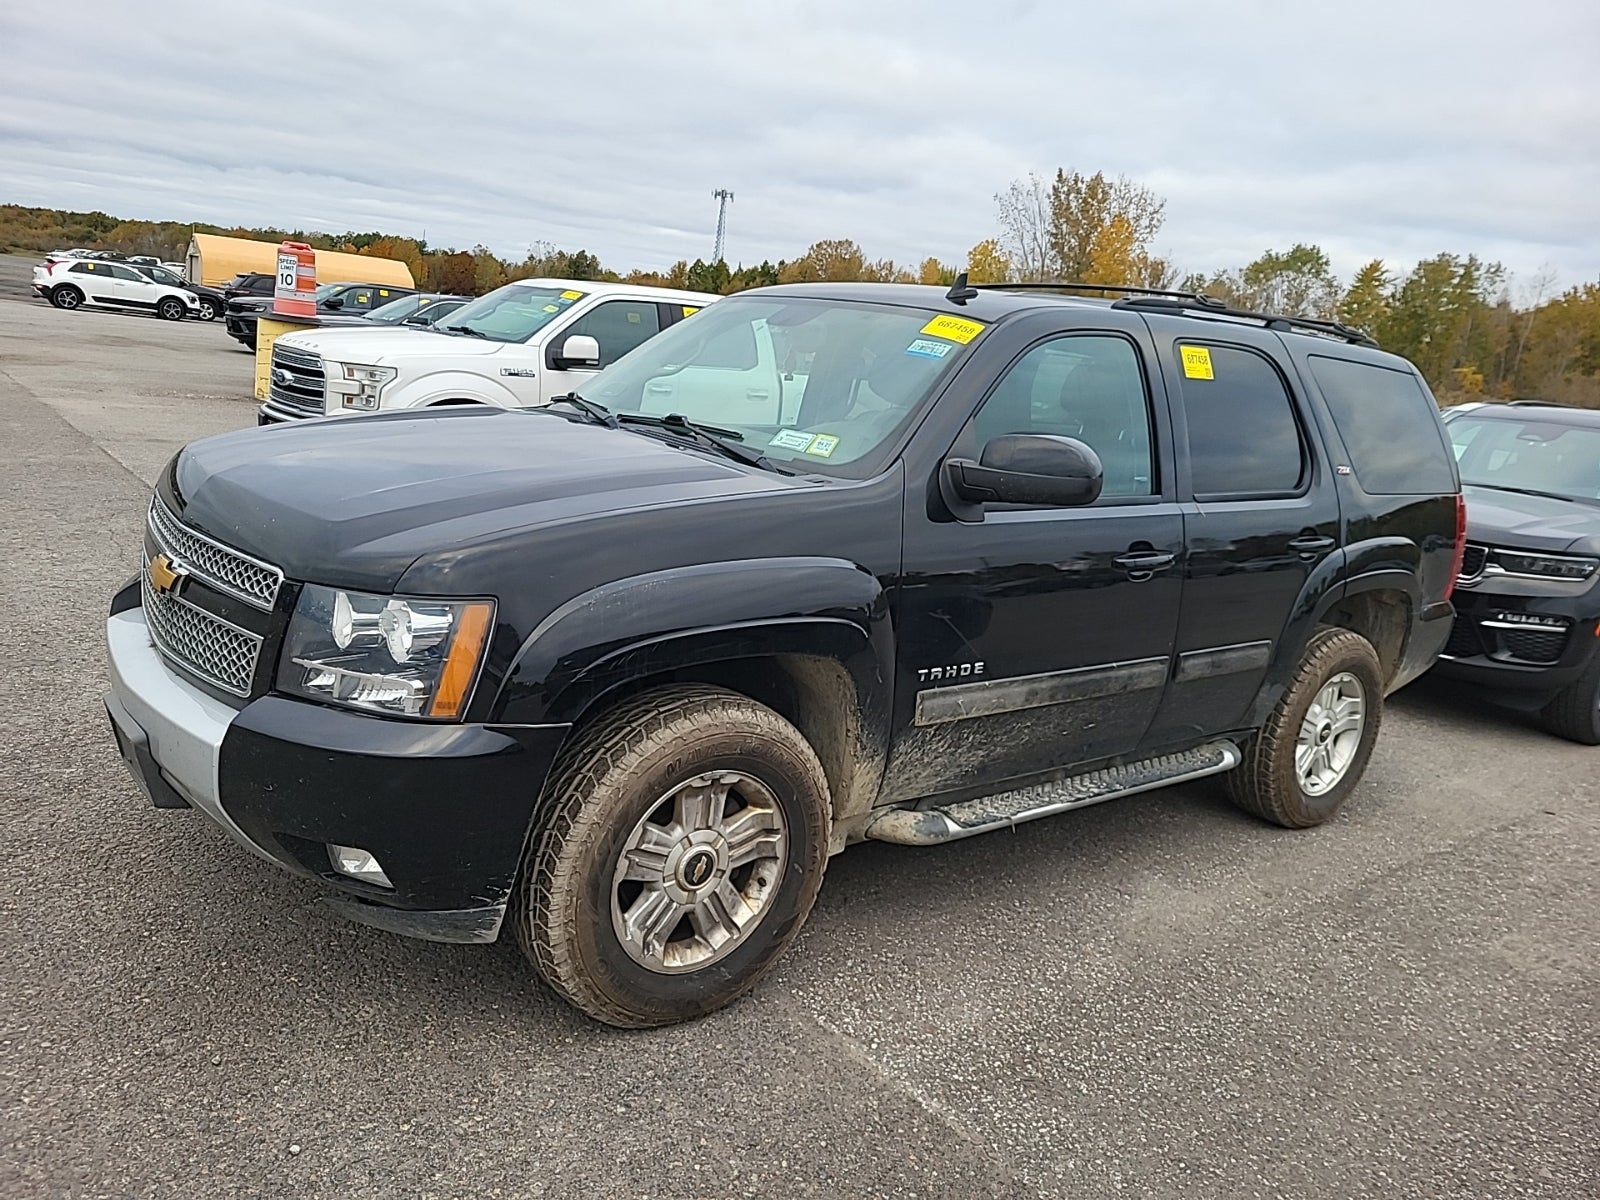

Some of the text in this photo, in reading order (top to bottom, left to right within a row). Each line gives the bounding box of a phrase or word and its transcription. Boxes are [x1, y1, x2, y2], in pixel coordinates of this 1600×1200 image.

[280, 273, 294, 286] 10
[937, 320, 976, 335] 687458
[918, 662, 984, 682] TAHOE
